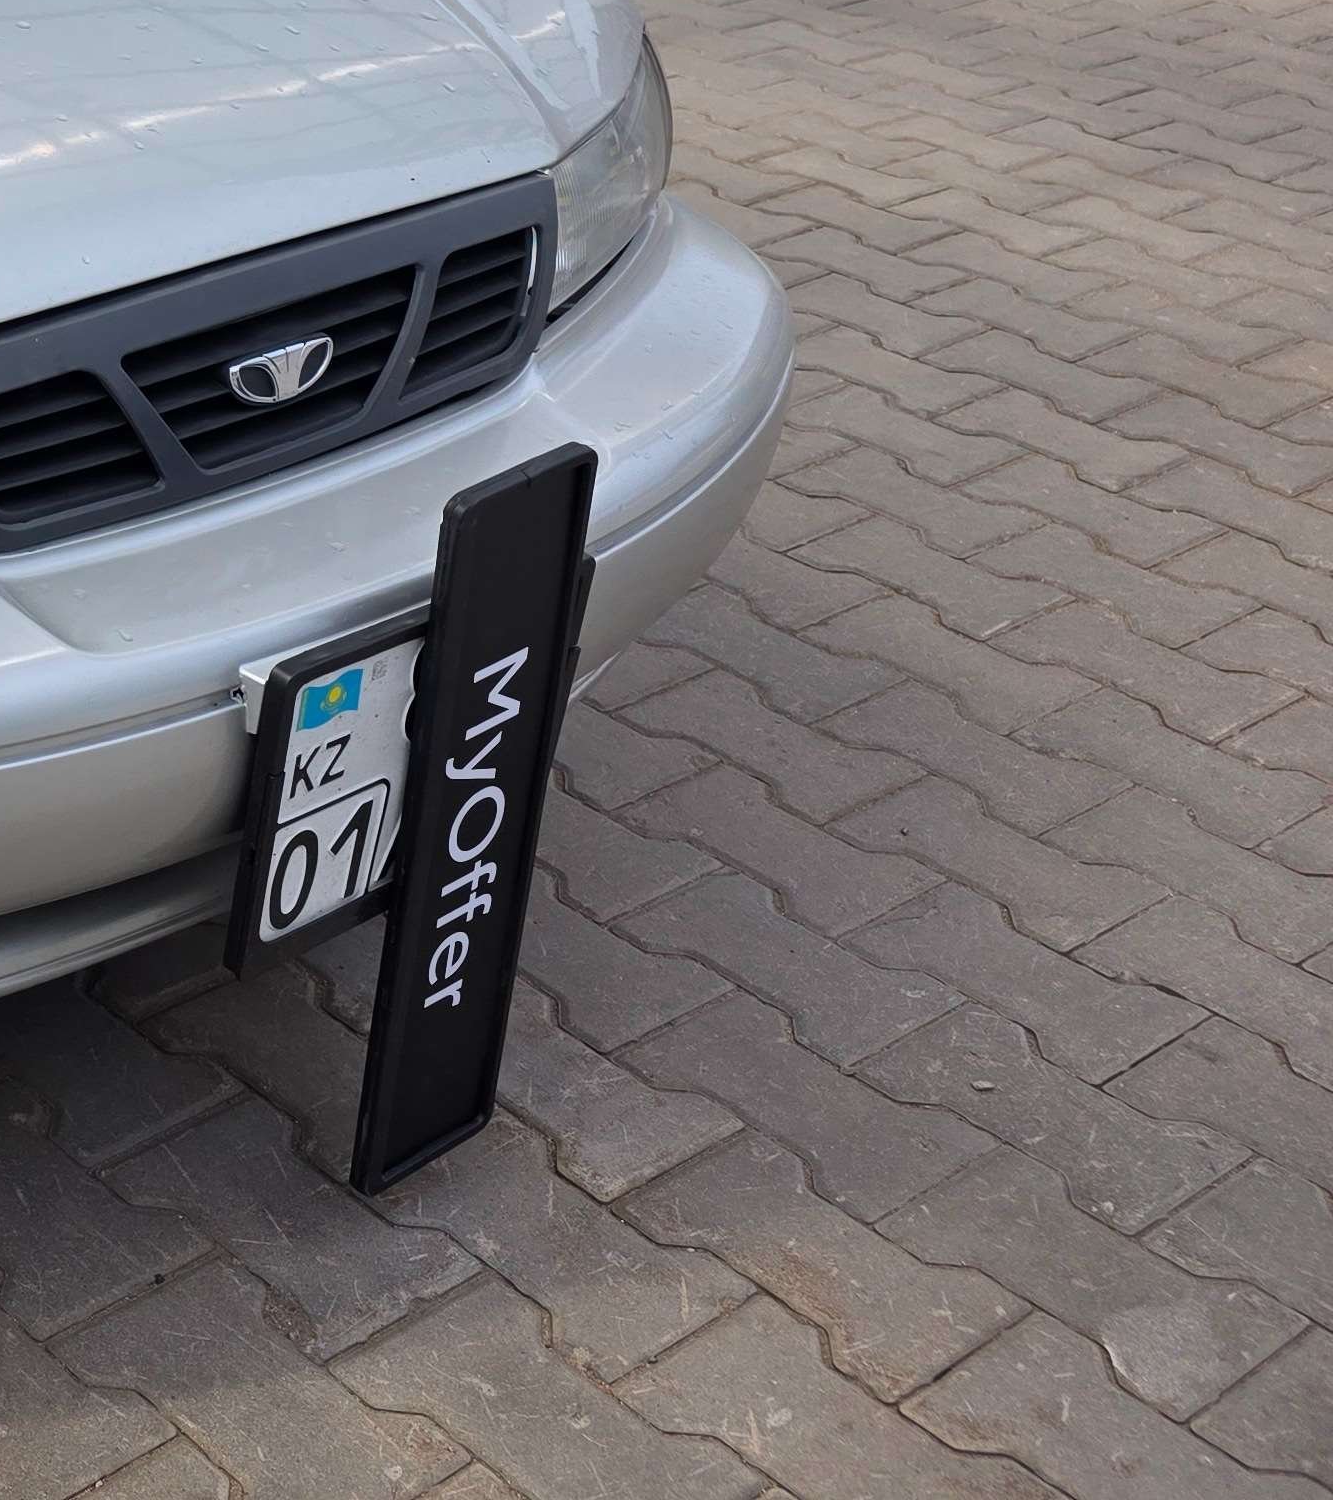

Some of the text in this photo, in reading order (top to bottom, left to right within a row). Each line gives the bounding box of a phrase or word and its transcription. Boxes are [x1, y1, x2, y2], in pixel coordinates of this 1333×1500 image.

[289, 733, 352, 799] KZ
[424, 647, 528, 1007] MyOffer
[268, 799, 374, 931] 01
